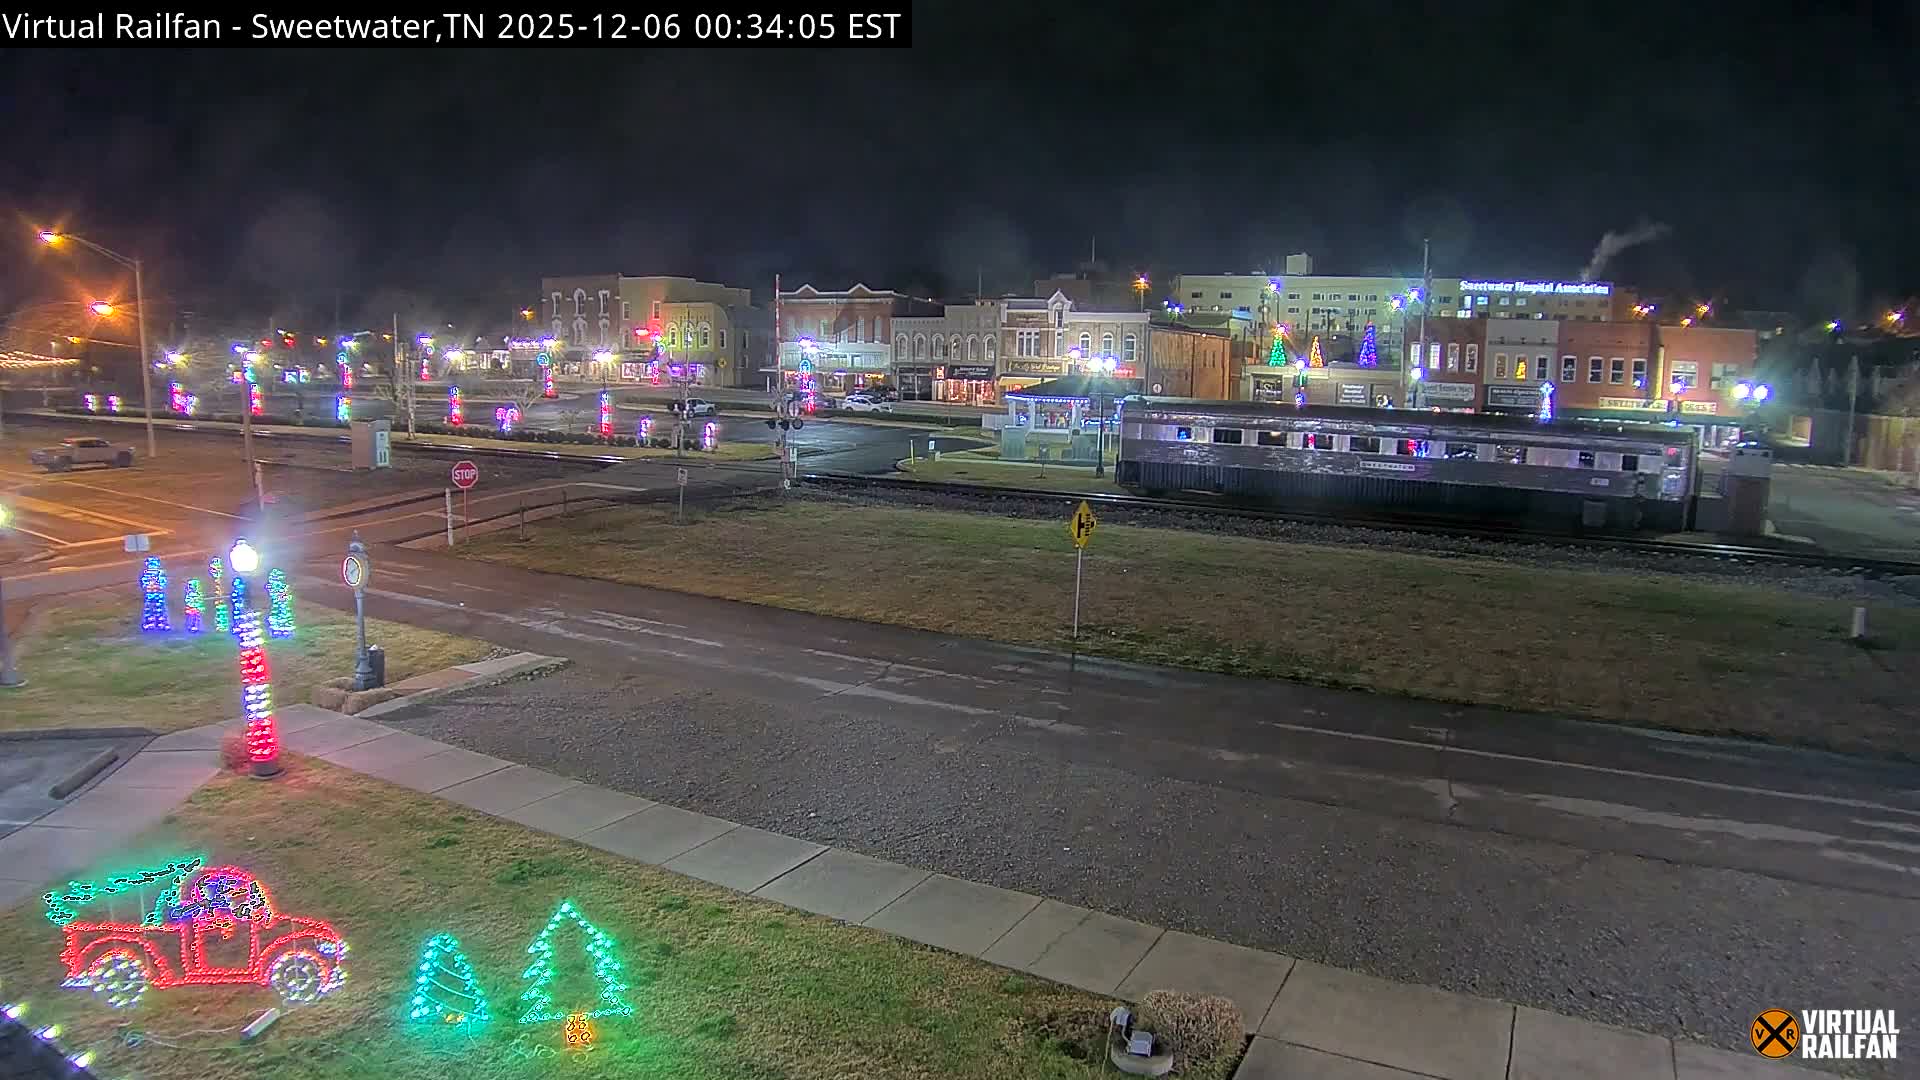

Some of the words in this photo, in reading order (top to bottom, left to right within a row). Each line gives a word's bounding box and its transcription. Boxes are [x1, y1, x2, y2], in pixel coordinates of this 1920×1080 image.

[1460, 281, 1514, 292] Sweetwater
[1515, 281, 1554, 294] Hospital
[1555, 283, 1609, 295] Association
[454, 469, 476, 480] STOP
